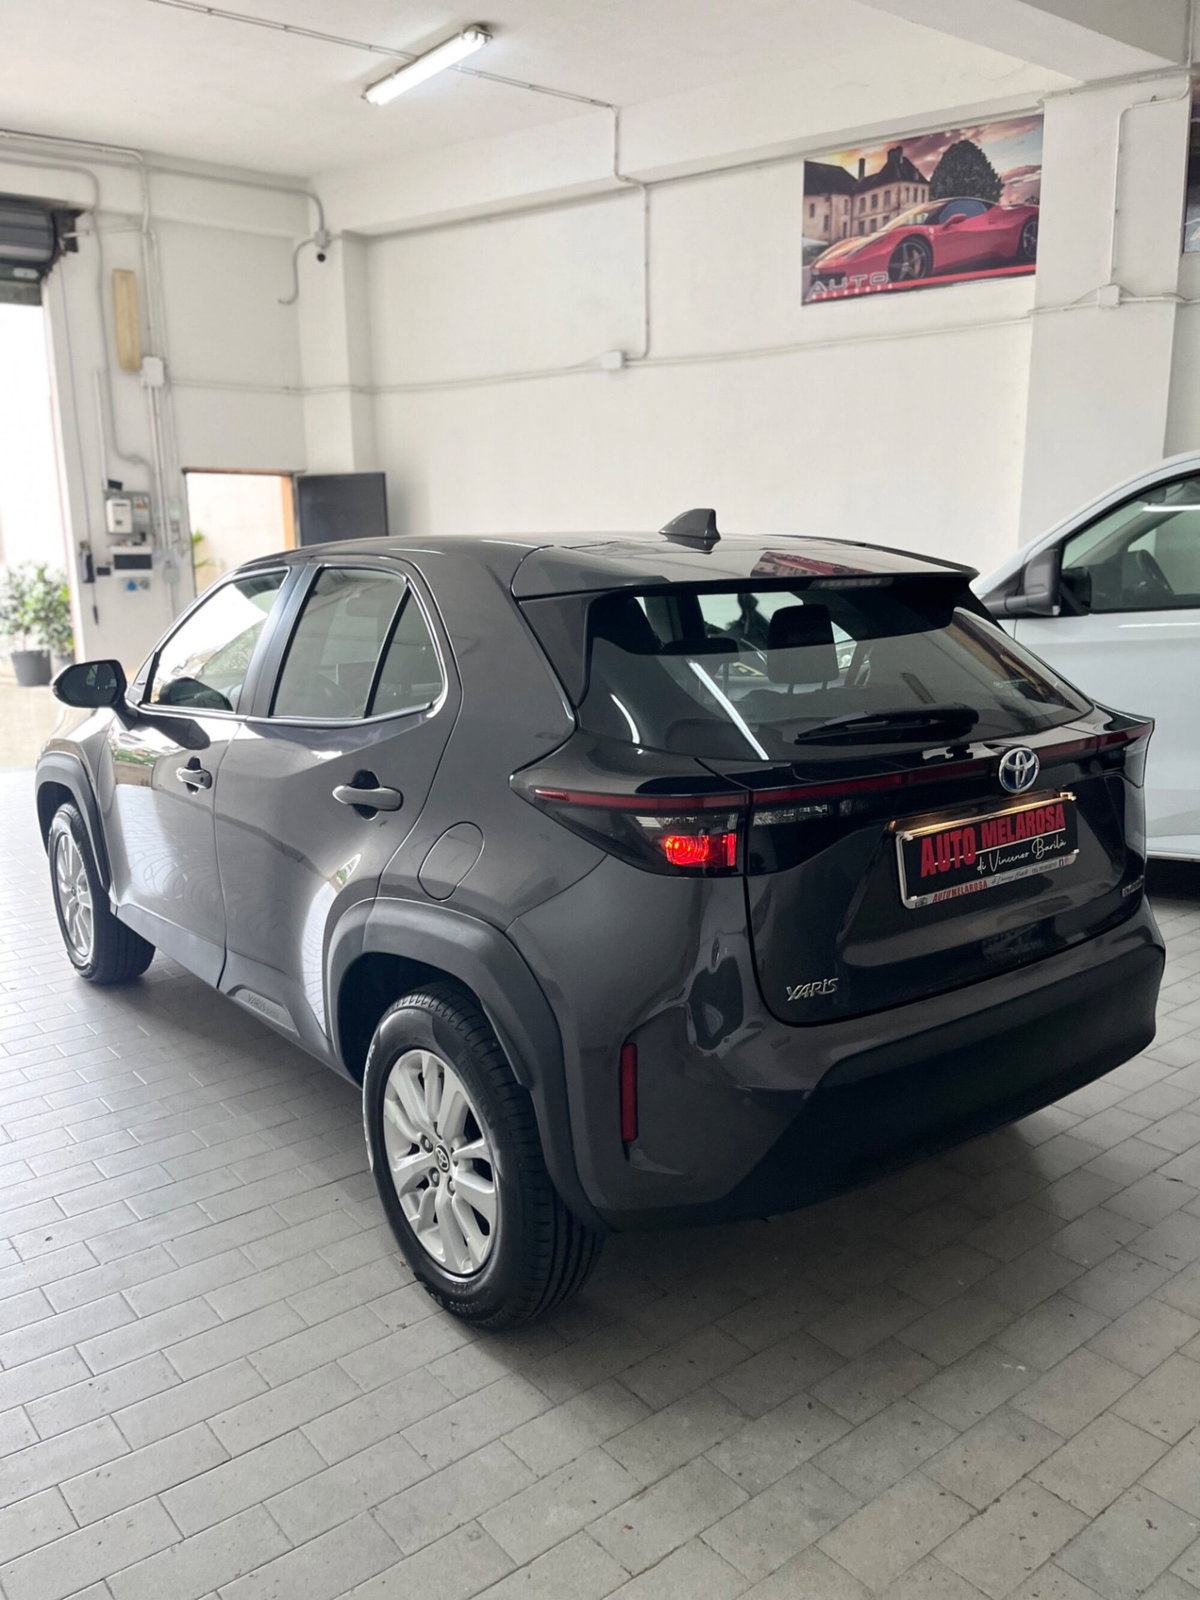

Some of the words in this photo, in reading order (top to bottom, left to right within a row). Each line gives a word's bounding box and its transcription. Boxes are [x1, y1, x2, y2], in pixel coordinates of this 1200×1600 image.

[805, 271, 889, 302] AUTO
[921, 827, 976, 878] AUTO
[981, 803, 1066, 849] MELAROSA
[977, 855, 987, 874] di
[786, 978, 839, 1001] YARIS
